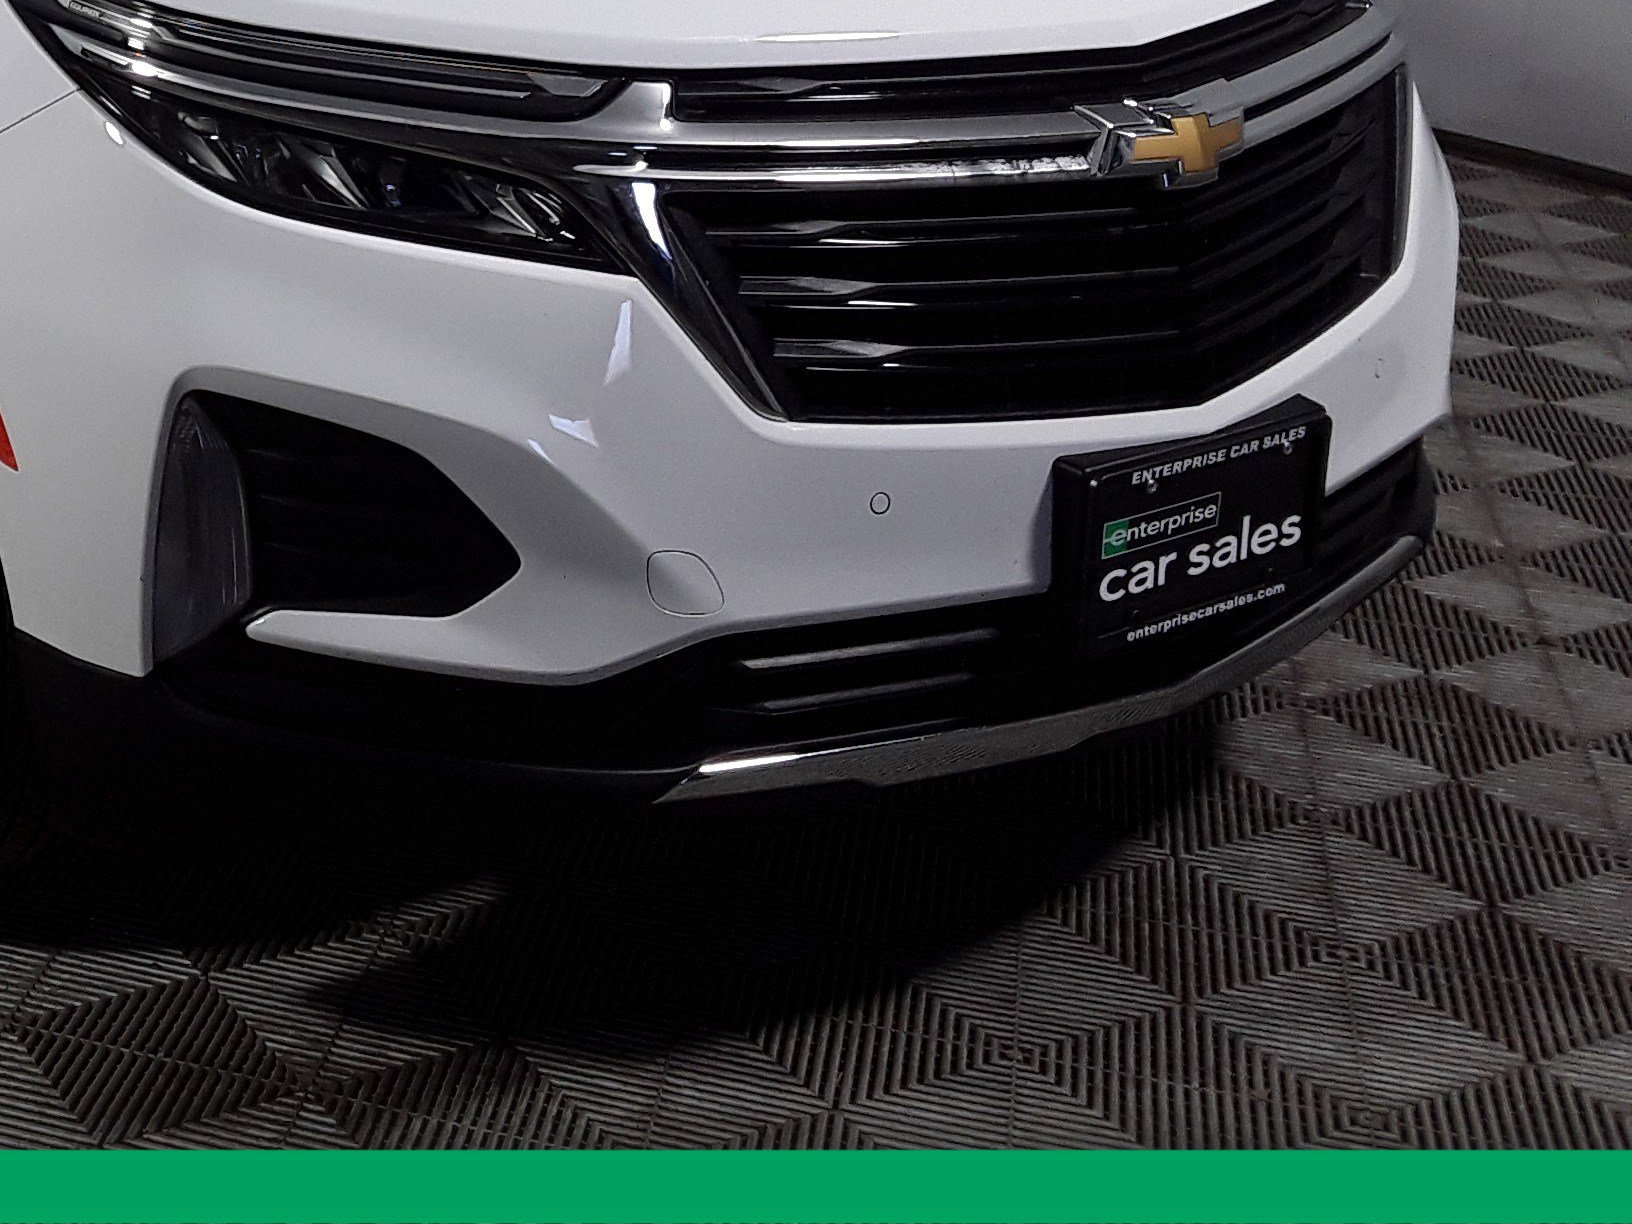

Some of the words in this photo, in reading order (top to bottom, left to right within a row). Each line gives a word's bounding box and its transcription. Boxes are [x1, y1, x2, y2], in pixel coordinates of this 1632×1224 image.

[1131, 449, 1227, 485] ENTERPRISE
[1229, 440, 1259, 459] CAR
[1262, 426, 1307, 449] SALES
[1108, 503, 1217, 546] enterprise
[1099, 551, 1178, 602] car
[1186, 514, 1303, 576] sales
[1126, 583, 1286, 642] enterprisecarsales.com
